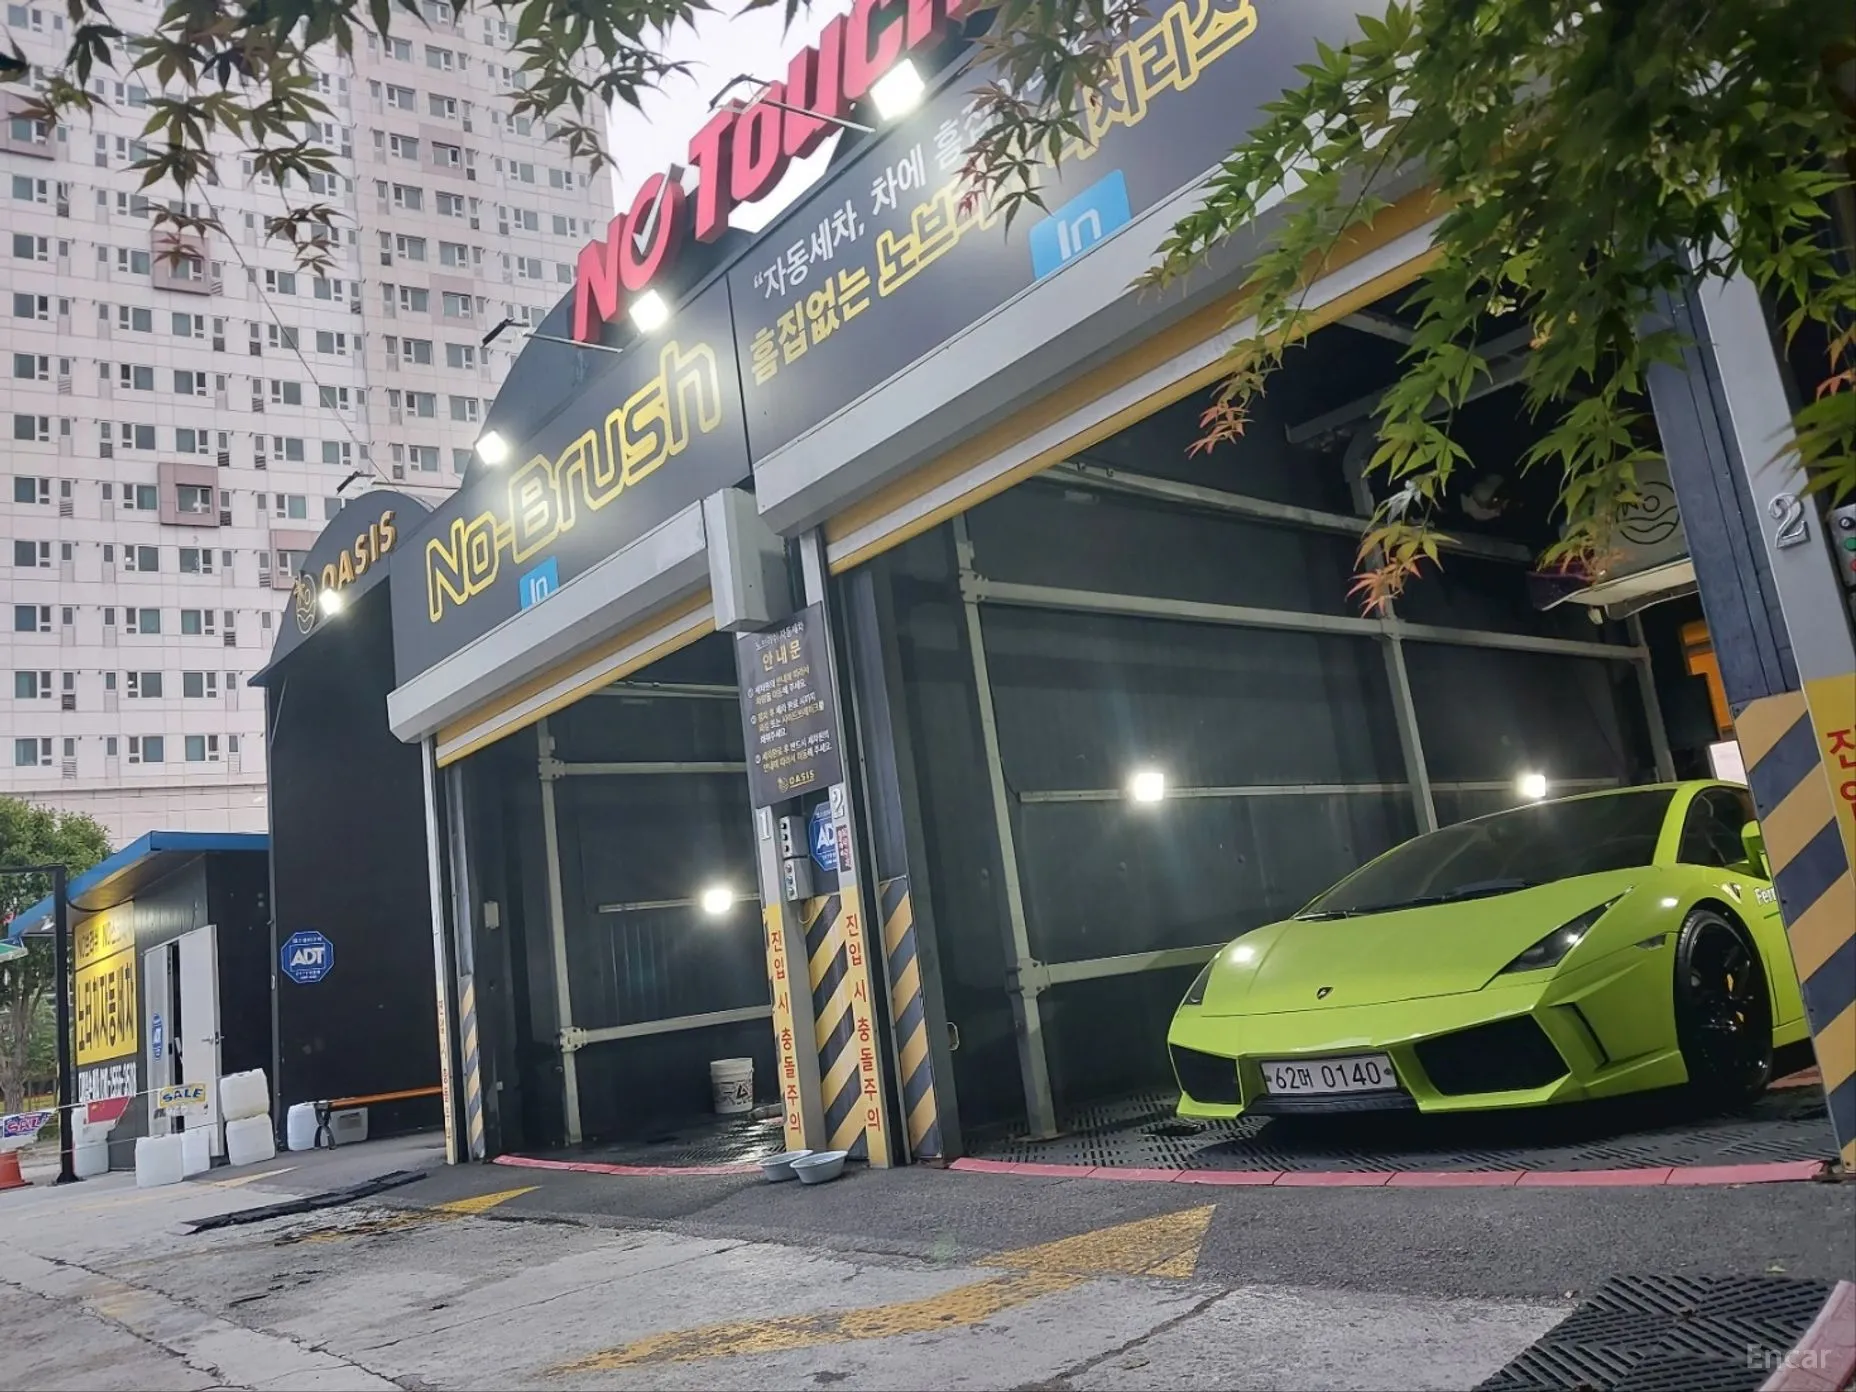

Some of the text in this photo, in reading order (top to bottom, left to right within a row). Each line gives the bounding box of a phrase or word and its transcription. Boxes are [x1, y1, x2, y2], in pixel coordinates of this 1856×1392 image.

[871, 143, 926, 216] 차에
[573, 171, 682, 342] NO
[751, 266, 870, 387] 흠집없는
[1768, 493, 1811, 549] 2
[321, 510, 396, 592] OASIS
[788, 769, 815, 785] OASIS
[760, 809, 771, 840] 1
[832, 787, 845, 819] 2
[817, 822, 836, 853] AD
[290, 947, 325, 966] ADT
[771, 930, 802, 1135] 진입 시 충돌주의
[846, 913, 881, 1132] 진입 시 충돌주의
[162, 1087, 203, 1102] SALE
[1321, 1061, 1381, 1088] 0140
